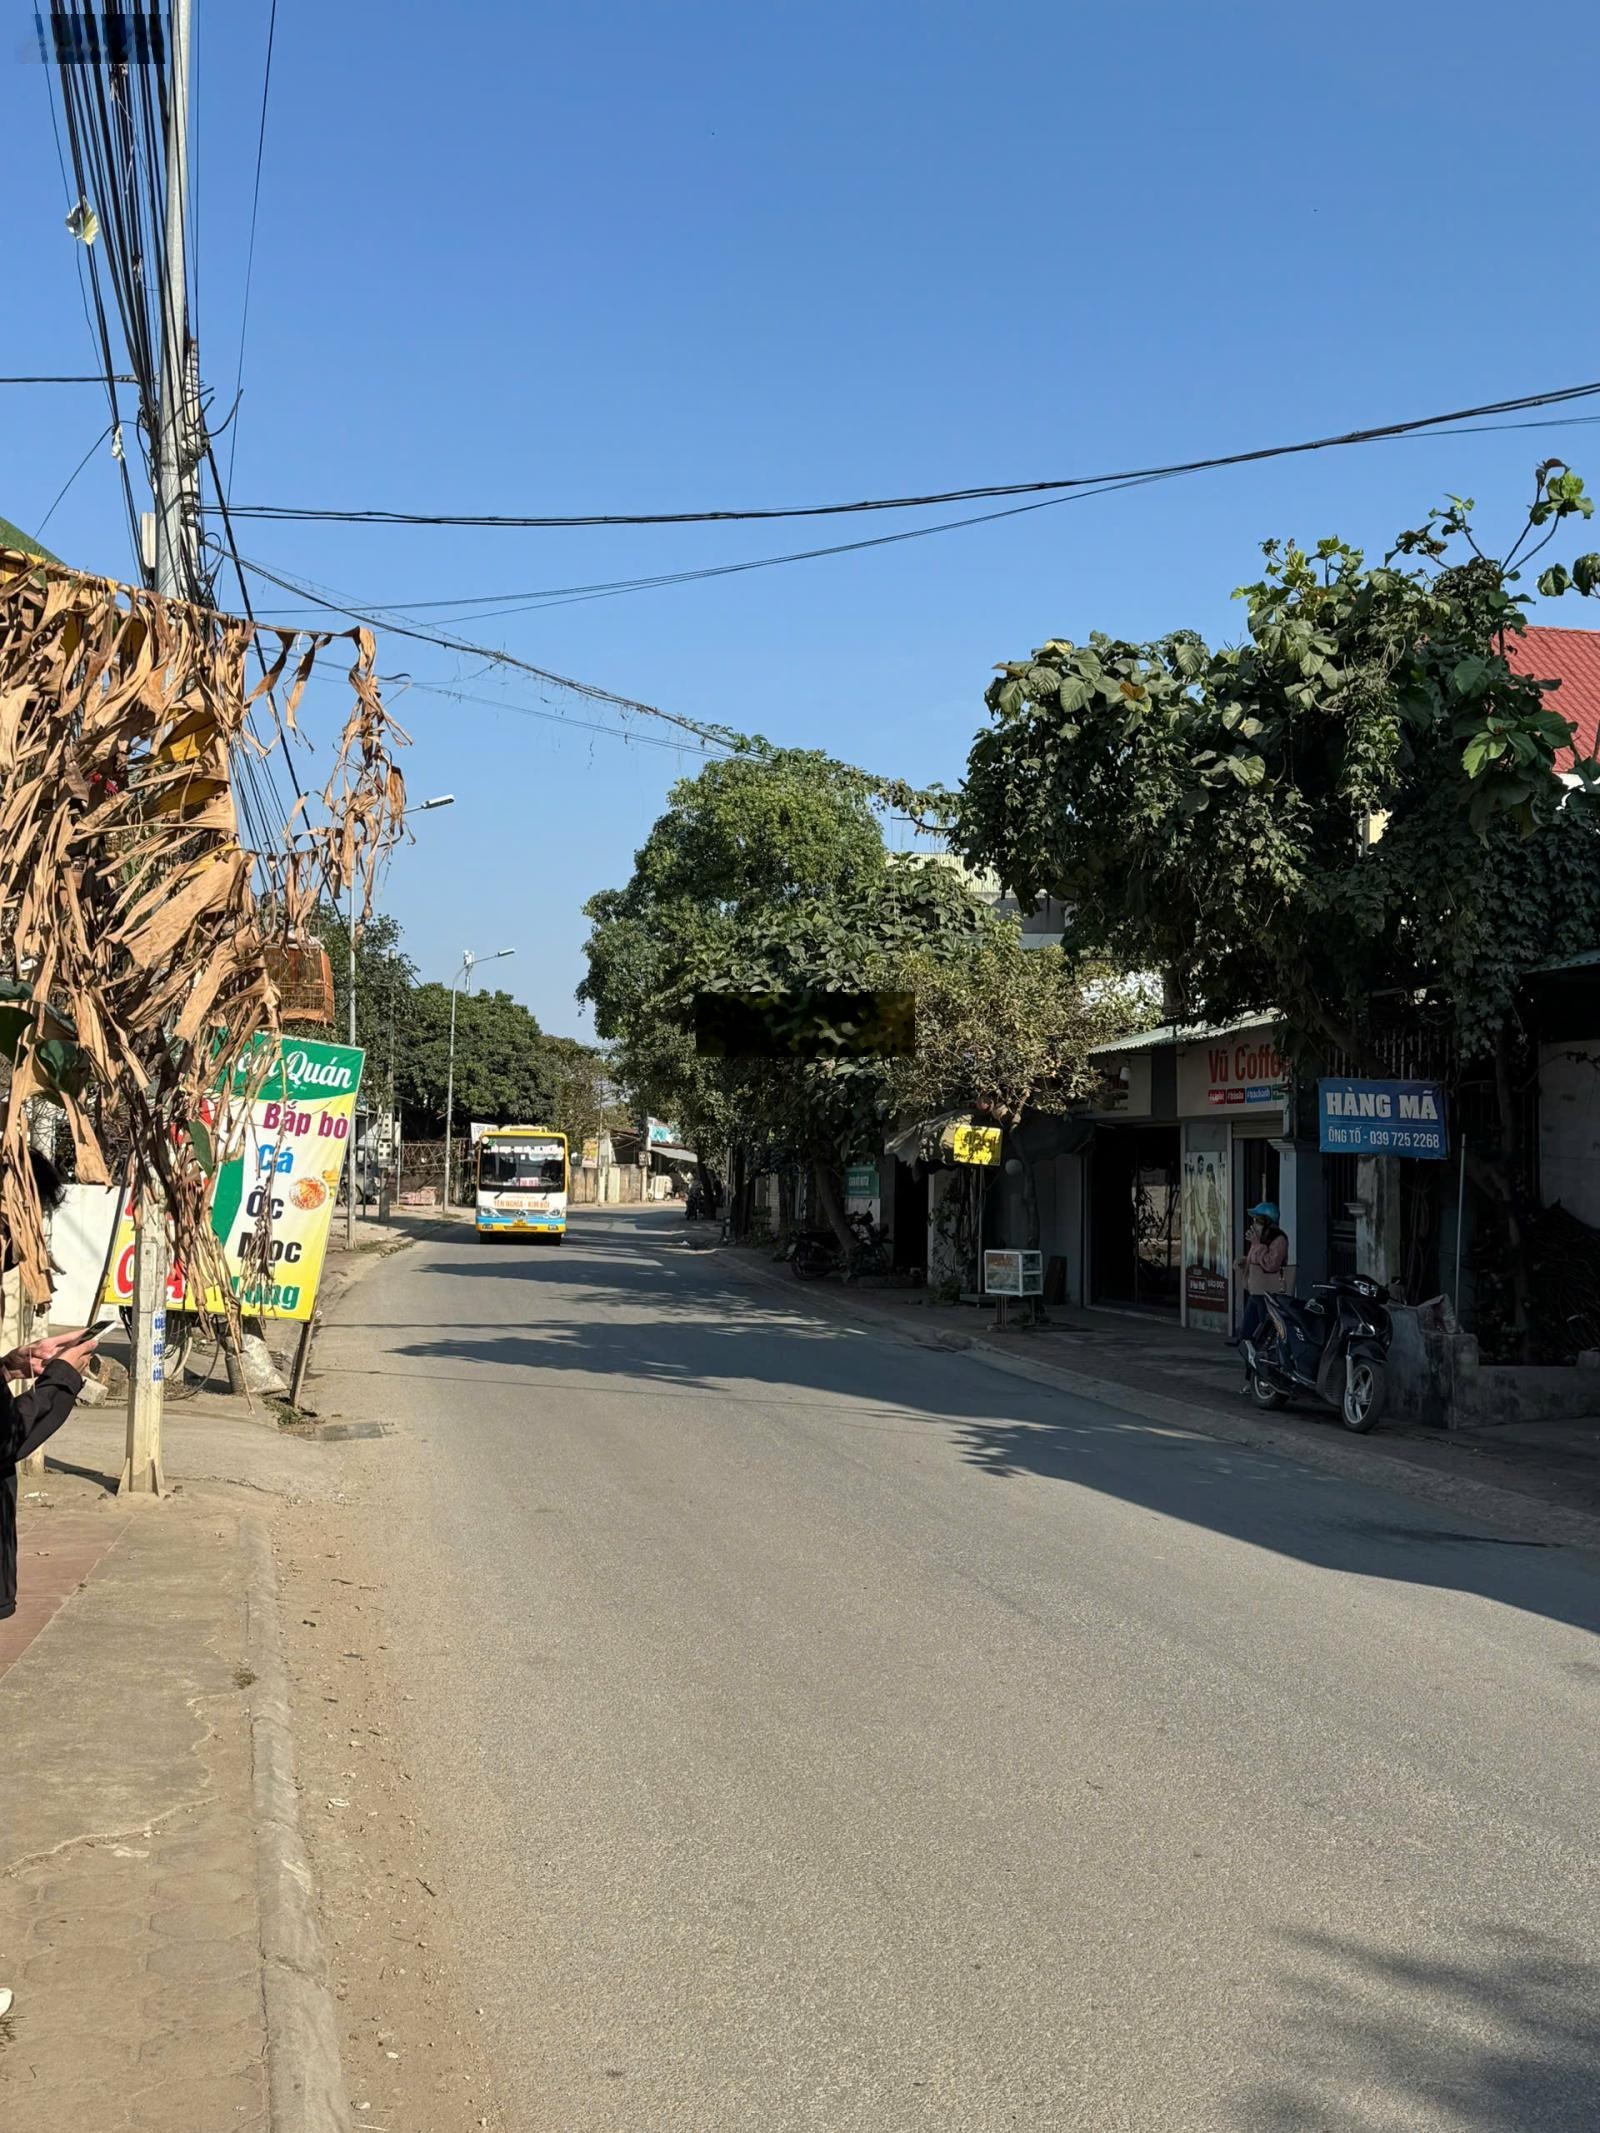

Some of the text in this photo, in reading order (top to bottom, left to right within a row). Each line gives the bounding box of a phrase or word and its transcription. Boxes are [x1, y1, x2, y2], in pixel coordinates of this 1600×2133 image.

[286, 1050, 352, 1088] Quán
[1208, 1043, 1291, 1083] Vũ Coffe
[263, 1100, 349, 1139] Bắp bò
[1326, 1086, 1438, 1120] HÀNG MÃ
[1328, 1126, 1347, 1143] ÔNG
[1370, 1131, 1389, 1146] 039
[1391, 1132, 1411, 1147] 725
[1413, 1133, 1440, 1149] 2268
[258, 1143, 294, 1174] Cá
